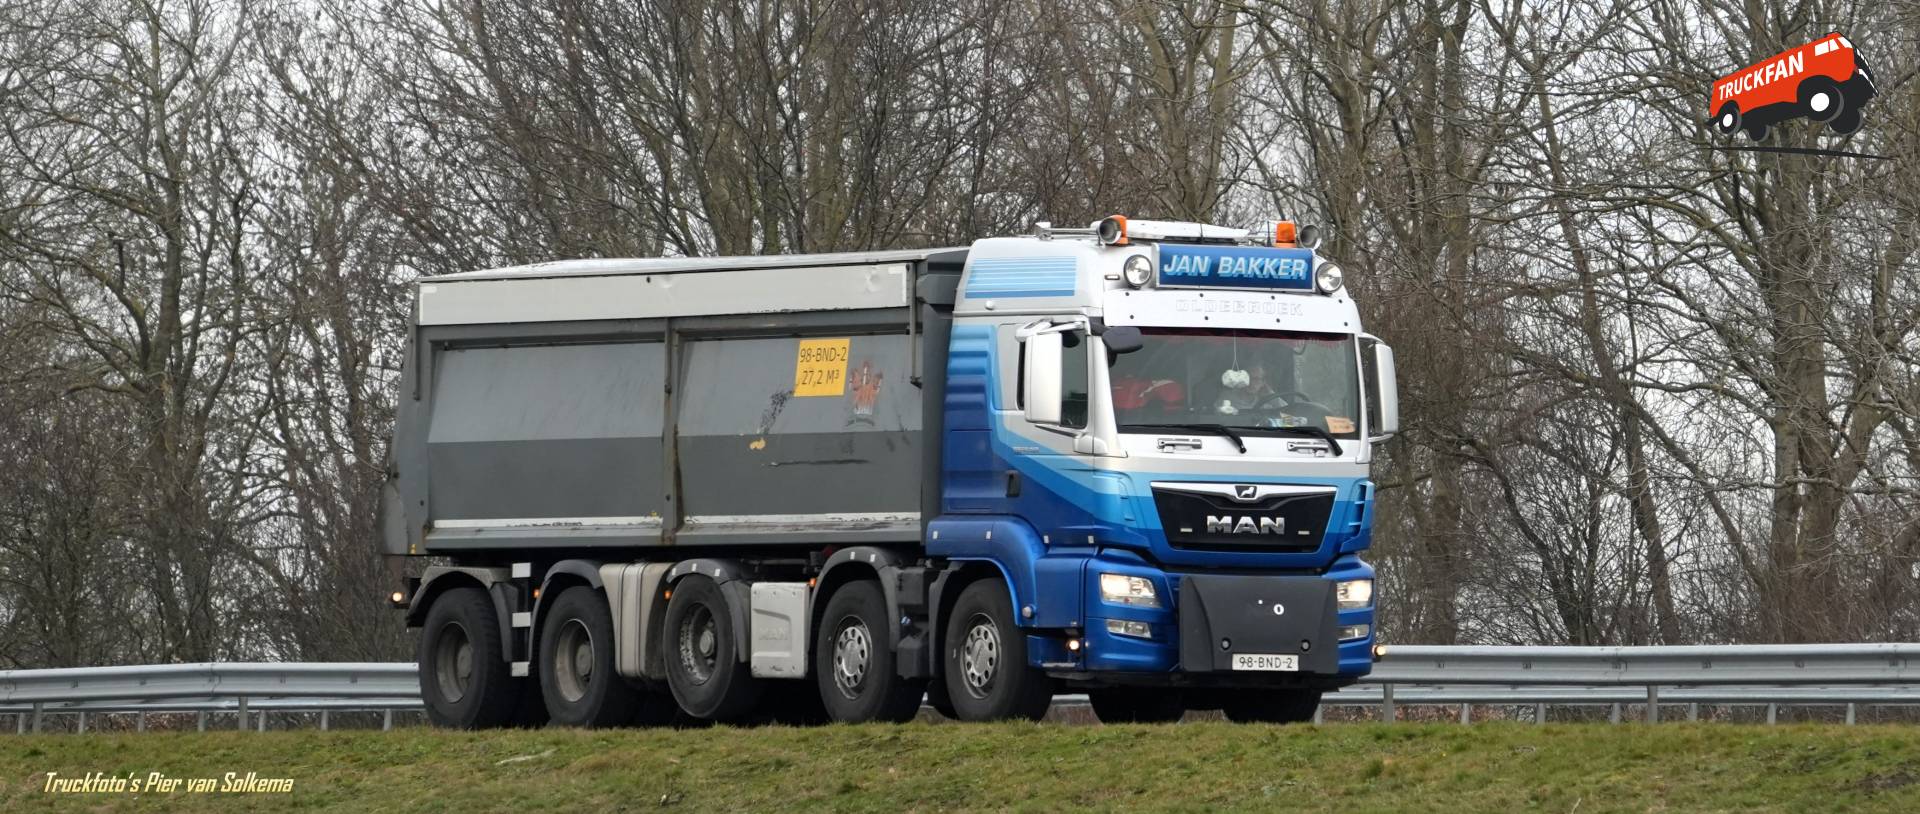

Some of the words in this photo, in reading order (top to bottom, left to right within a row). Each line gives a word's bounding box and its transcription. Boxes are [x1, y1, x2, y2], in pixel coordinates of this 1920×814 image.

[1163, 255, 1211, 277] JAN
[1217, 256, 1308, 280] BAKKER
[800, 347, 847, 362] 98-BND-2
[801, 370, 823, 387] 27,2
[1207, 515, 1285, 534] MAN
[1239, 657, 1293, 669] 98-BND-2
